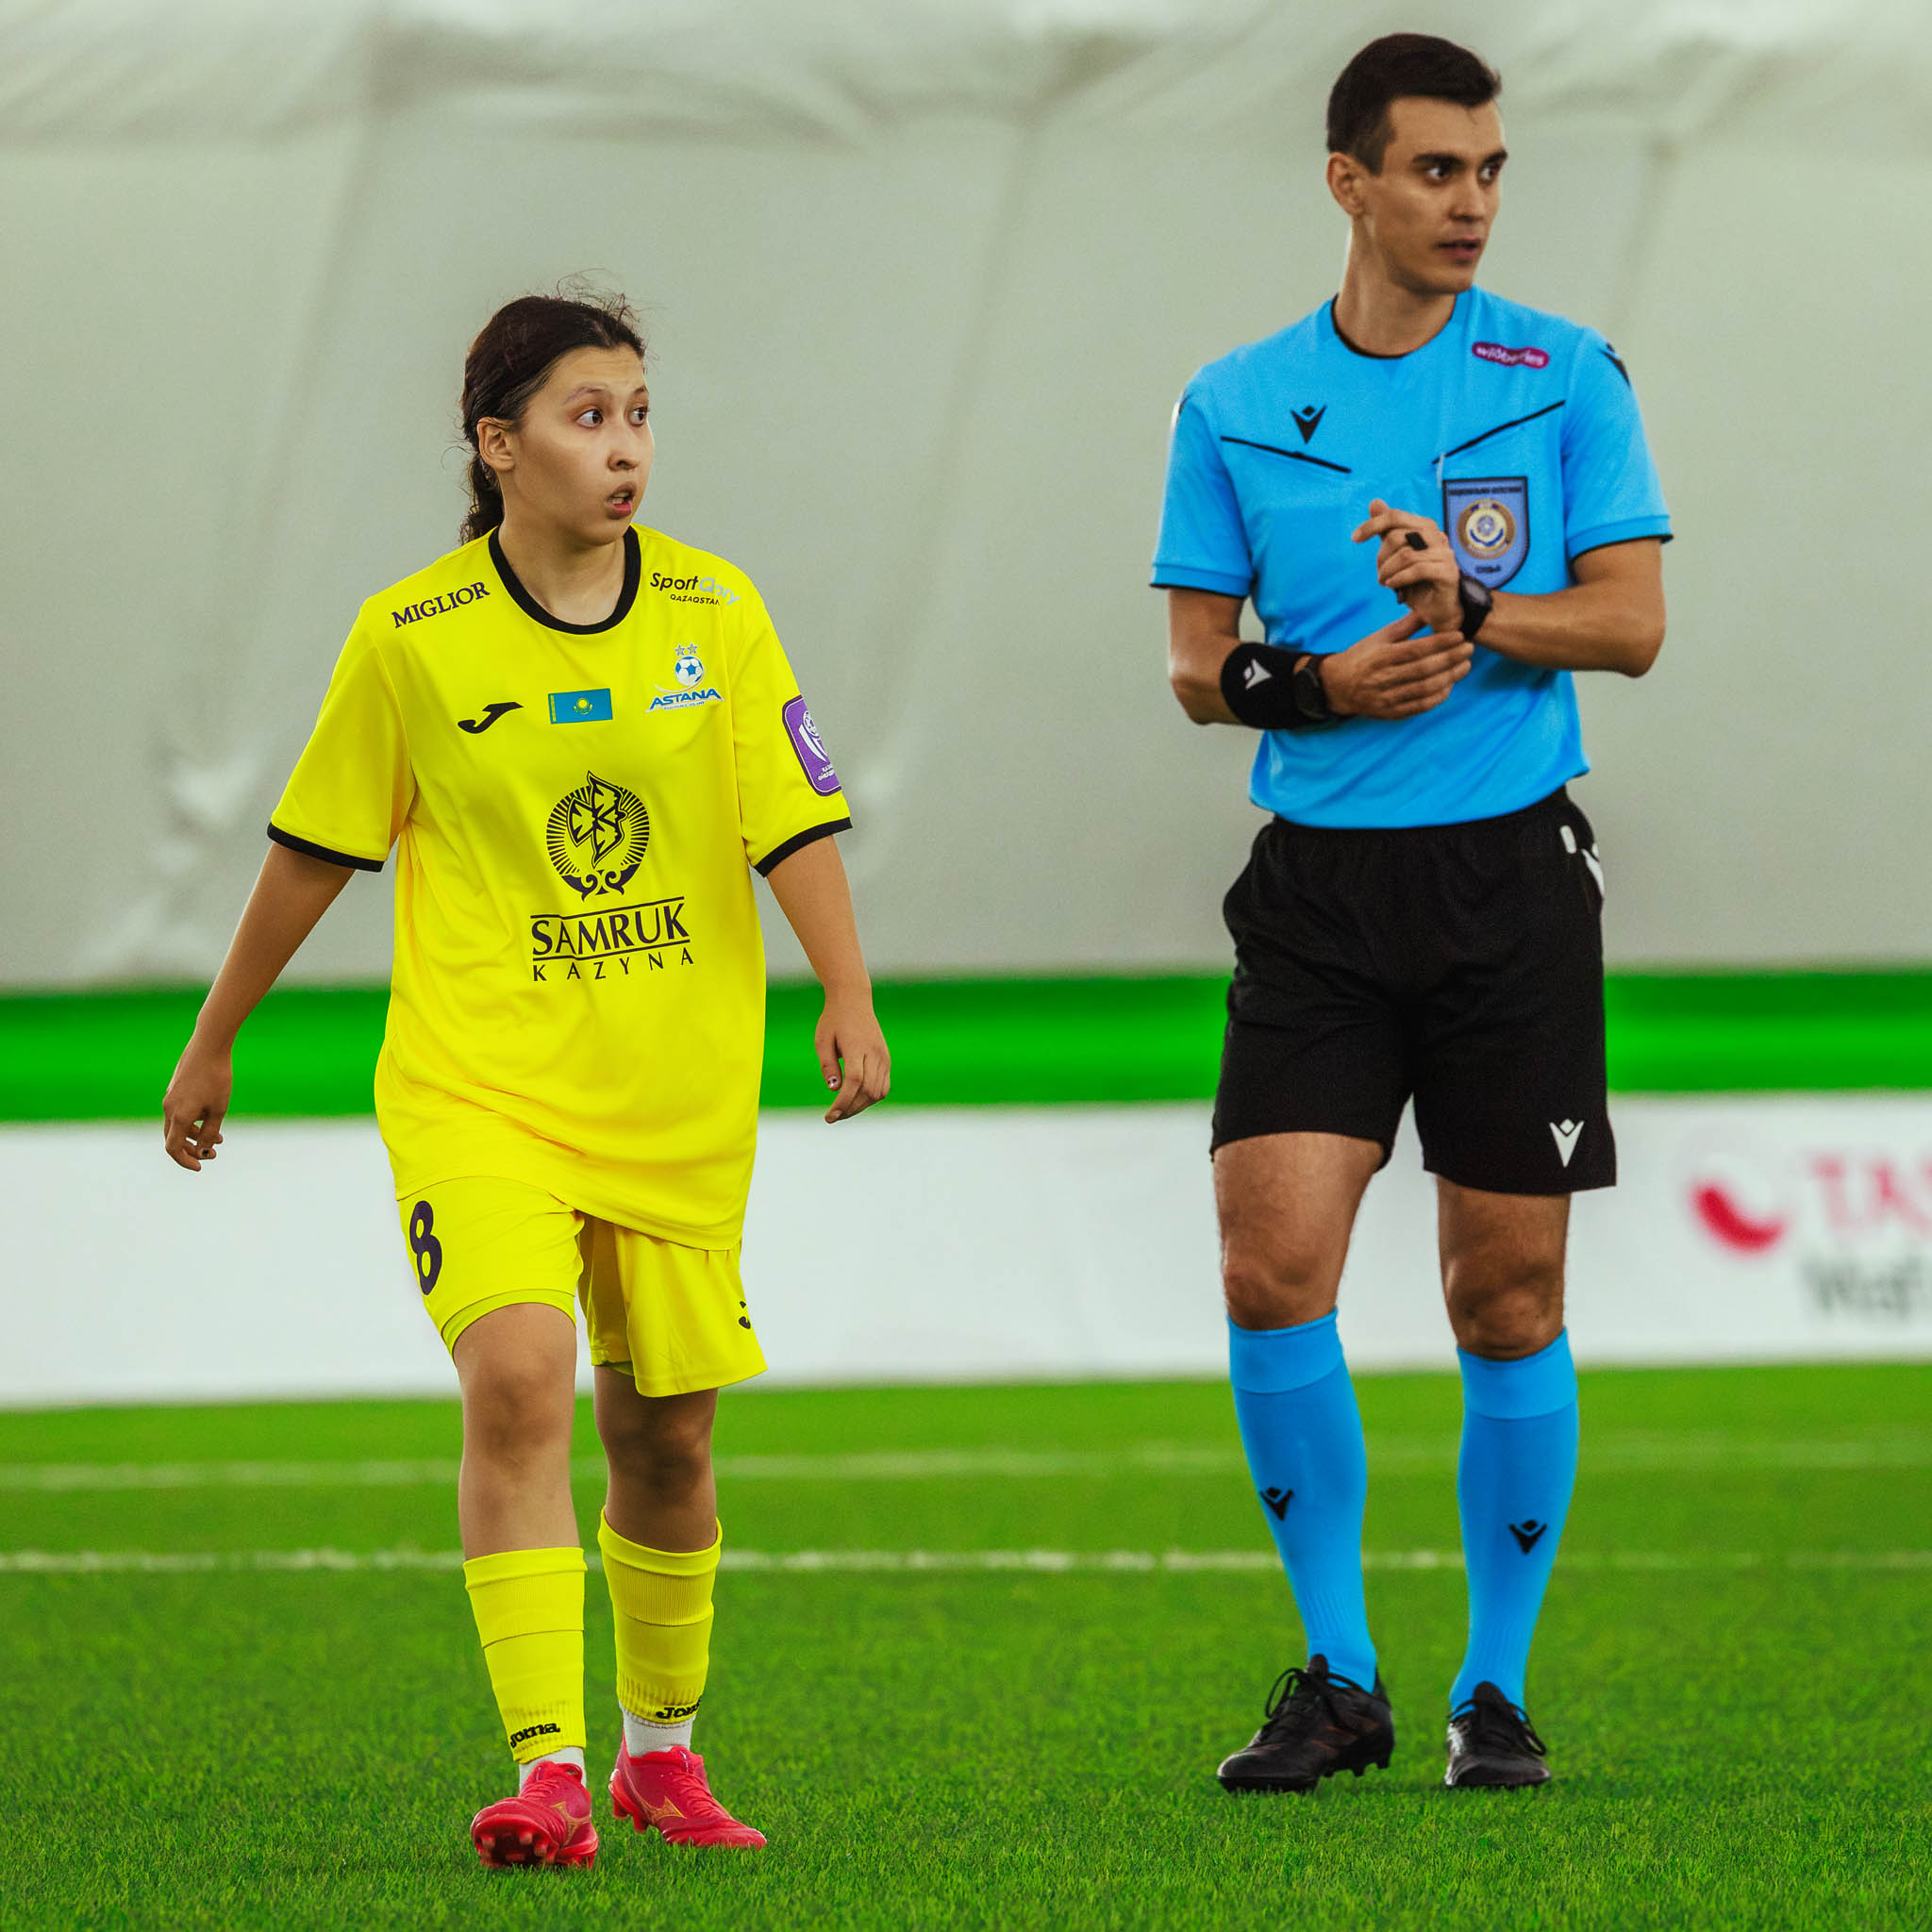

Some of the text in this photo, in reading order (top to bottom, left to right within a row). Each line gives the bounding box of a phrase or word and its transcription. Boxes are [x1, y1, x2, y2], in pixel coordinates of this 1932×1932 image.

[391, 581, 491, 628] MIGLIOR
[649, 688, 723, 710] ASTANA
[531, 903, 690, 956] SAMRUK
[533, 946, 694, 982] KAZYNA
[408, 1200, 443, 1296] 8
[656, 1694, 703, 1720] Jom
